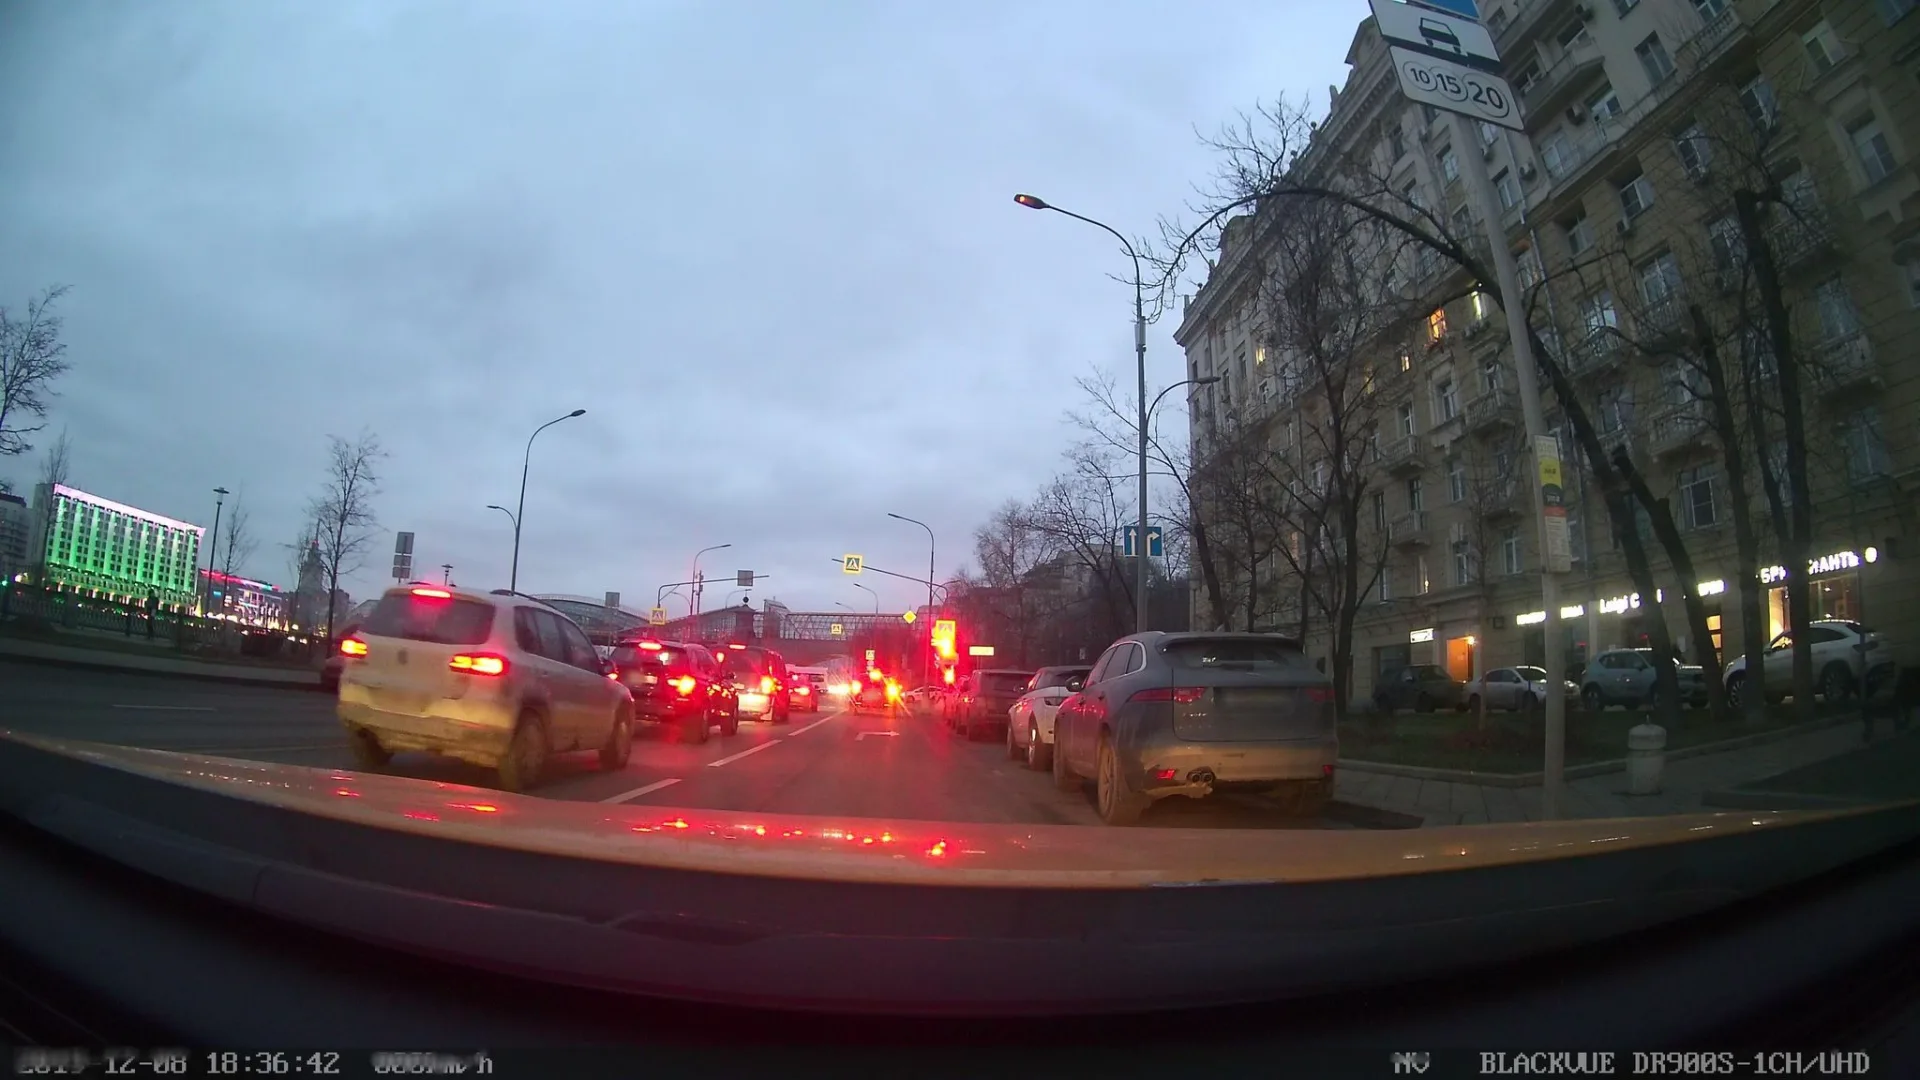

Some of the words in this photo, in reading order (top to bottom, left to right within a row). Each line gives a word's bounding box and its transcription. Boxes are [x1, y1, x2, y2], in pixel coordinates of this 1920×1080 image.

[1410, 67, 1430, 84] 10
[1436, 73, 1461, 94] 15
[1468, 81, 1504, 109] 20
